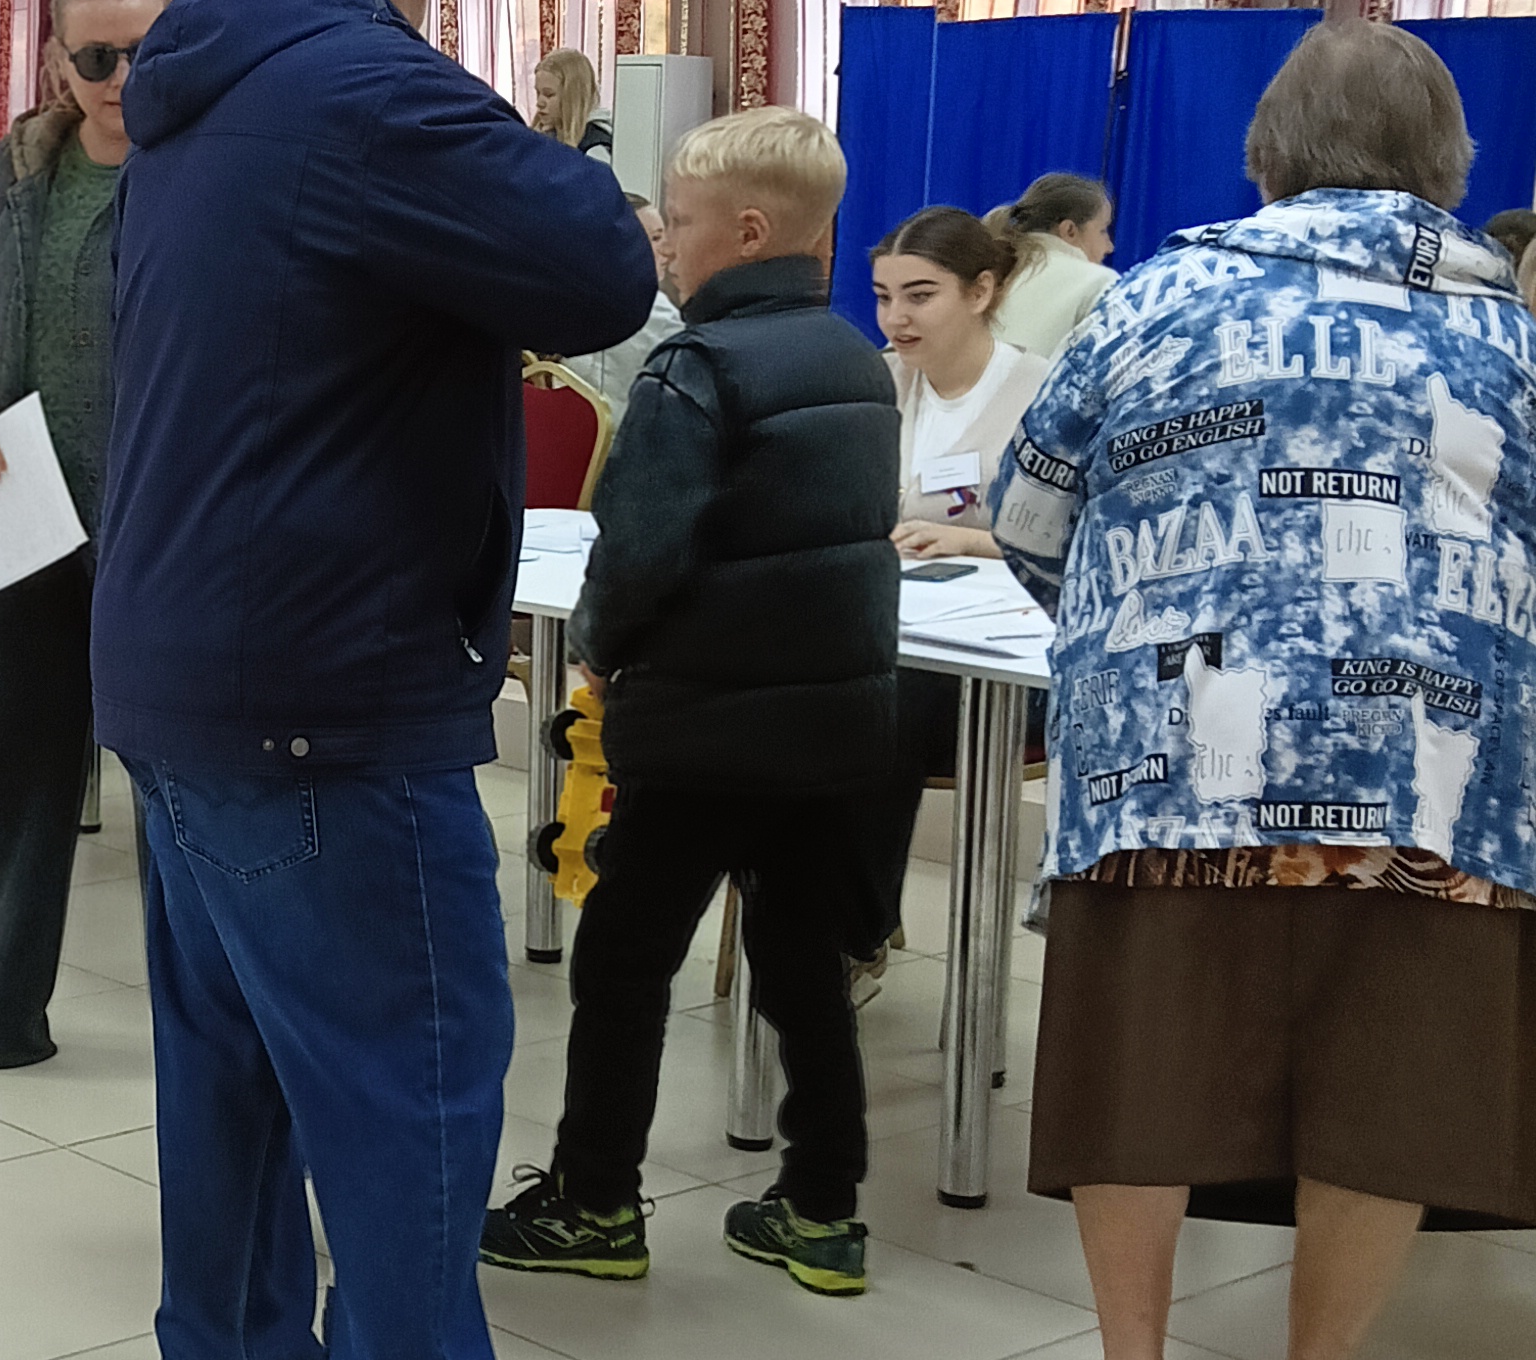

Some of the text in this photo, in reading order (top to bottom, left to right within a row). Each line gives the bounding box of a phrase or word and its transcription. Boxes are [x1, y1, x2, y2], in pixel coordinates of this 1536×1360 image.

[1112, 400, 1260, 454] KING IS HAPPY
[1111, 419, 1262, 473] GO GO ENGLISH
[1261, 471, 1398, 503] NOT RETURN
[1339, 659, 1480, 696] KING IS HAPPY
[1333, 678, 1481, 717] GO GO EGLISH
[1090, 774, 1119, 803] NOT
[1259, 803, 1386, 830] NOT RETURN
